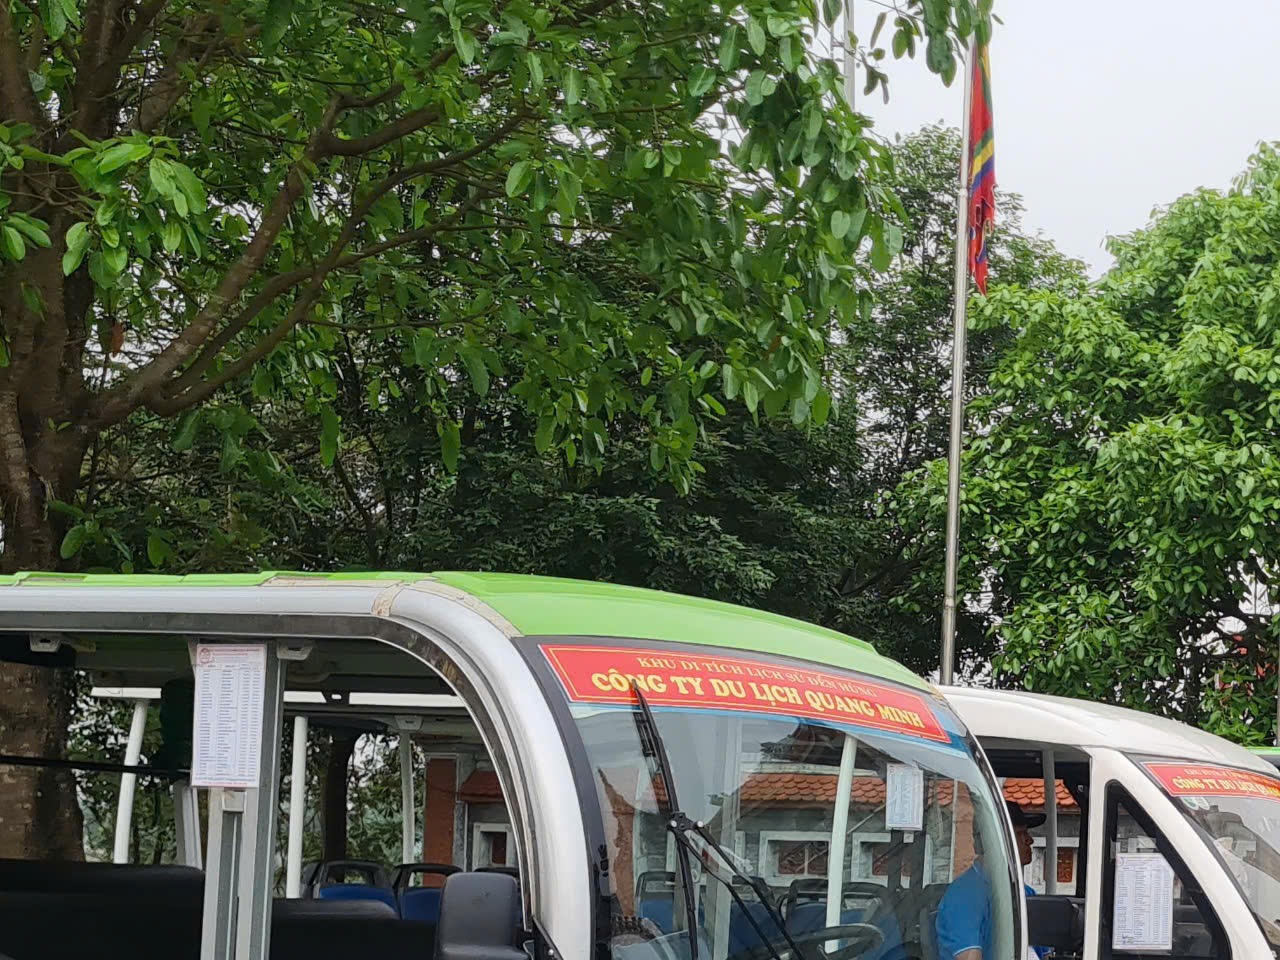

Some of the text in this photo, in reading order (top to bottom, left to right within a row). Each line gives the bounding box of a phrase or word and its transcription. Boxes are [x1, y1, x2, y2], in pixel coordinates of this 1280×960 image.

[637, 657, 677, 669] KHU
[681, 660, 701, 671] DI
[702, 661, 744, 675] TÍCH
[746, 667, 786, 681] LỊCH
[592, 668, 926, 729] CÔNG TY DU LỊCH QUANG MINH
